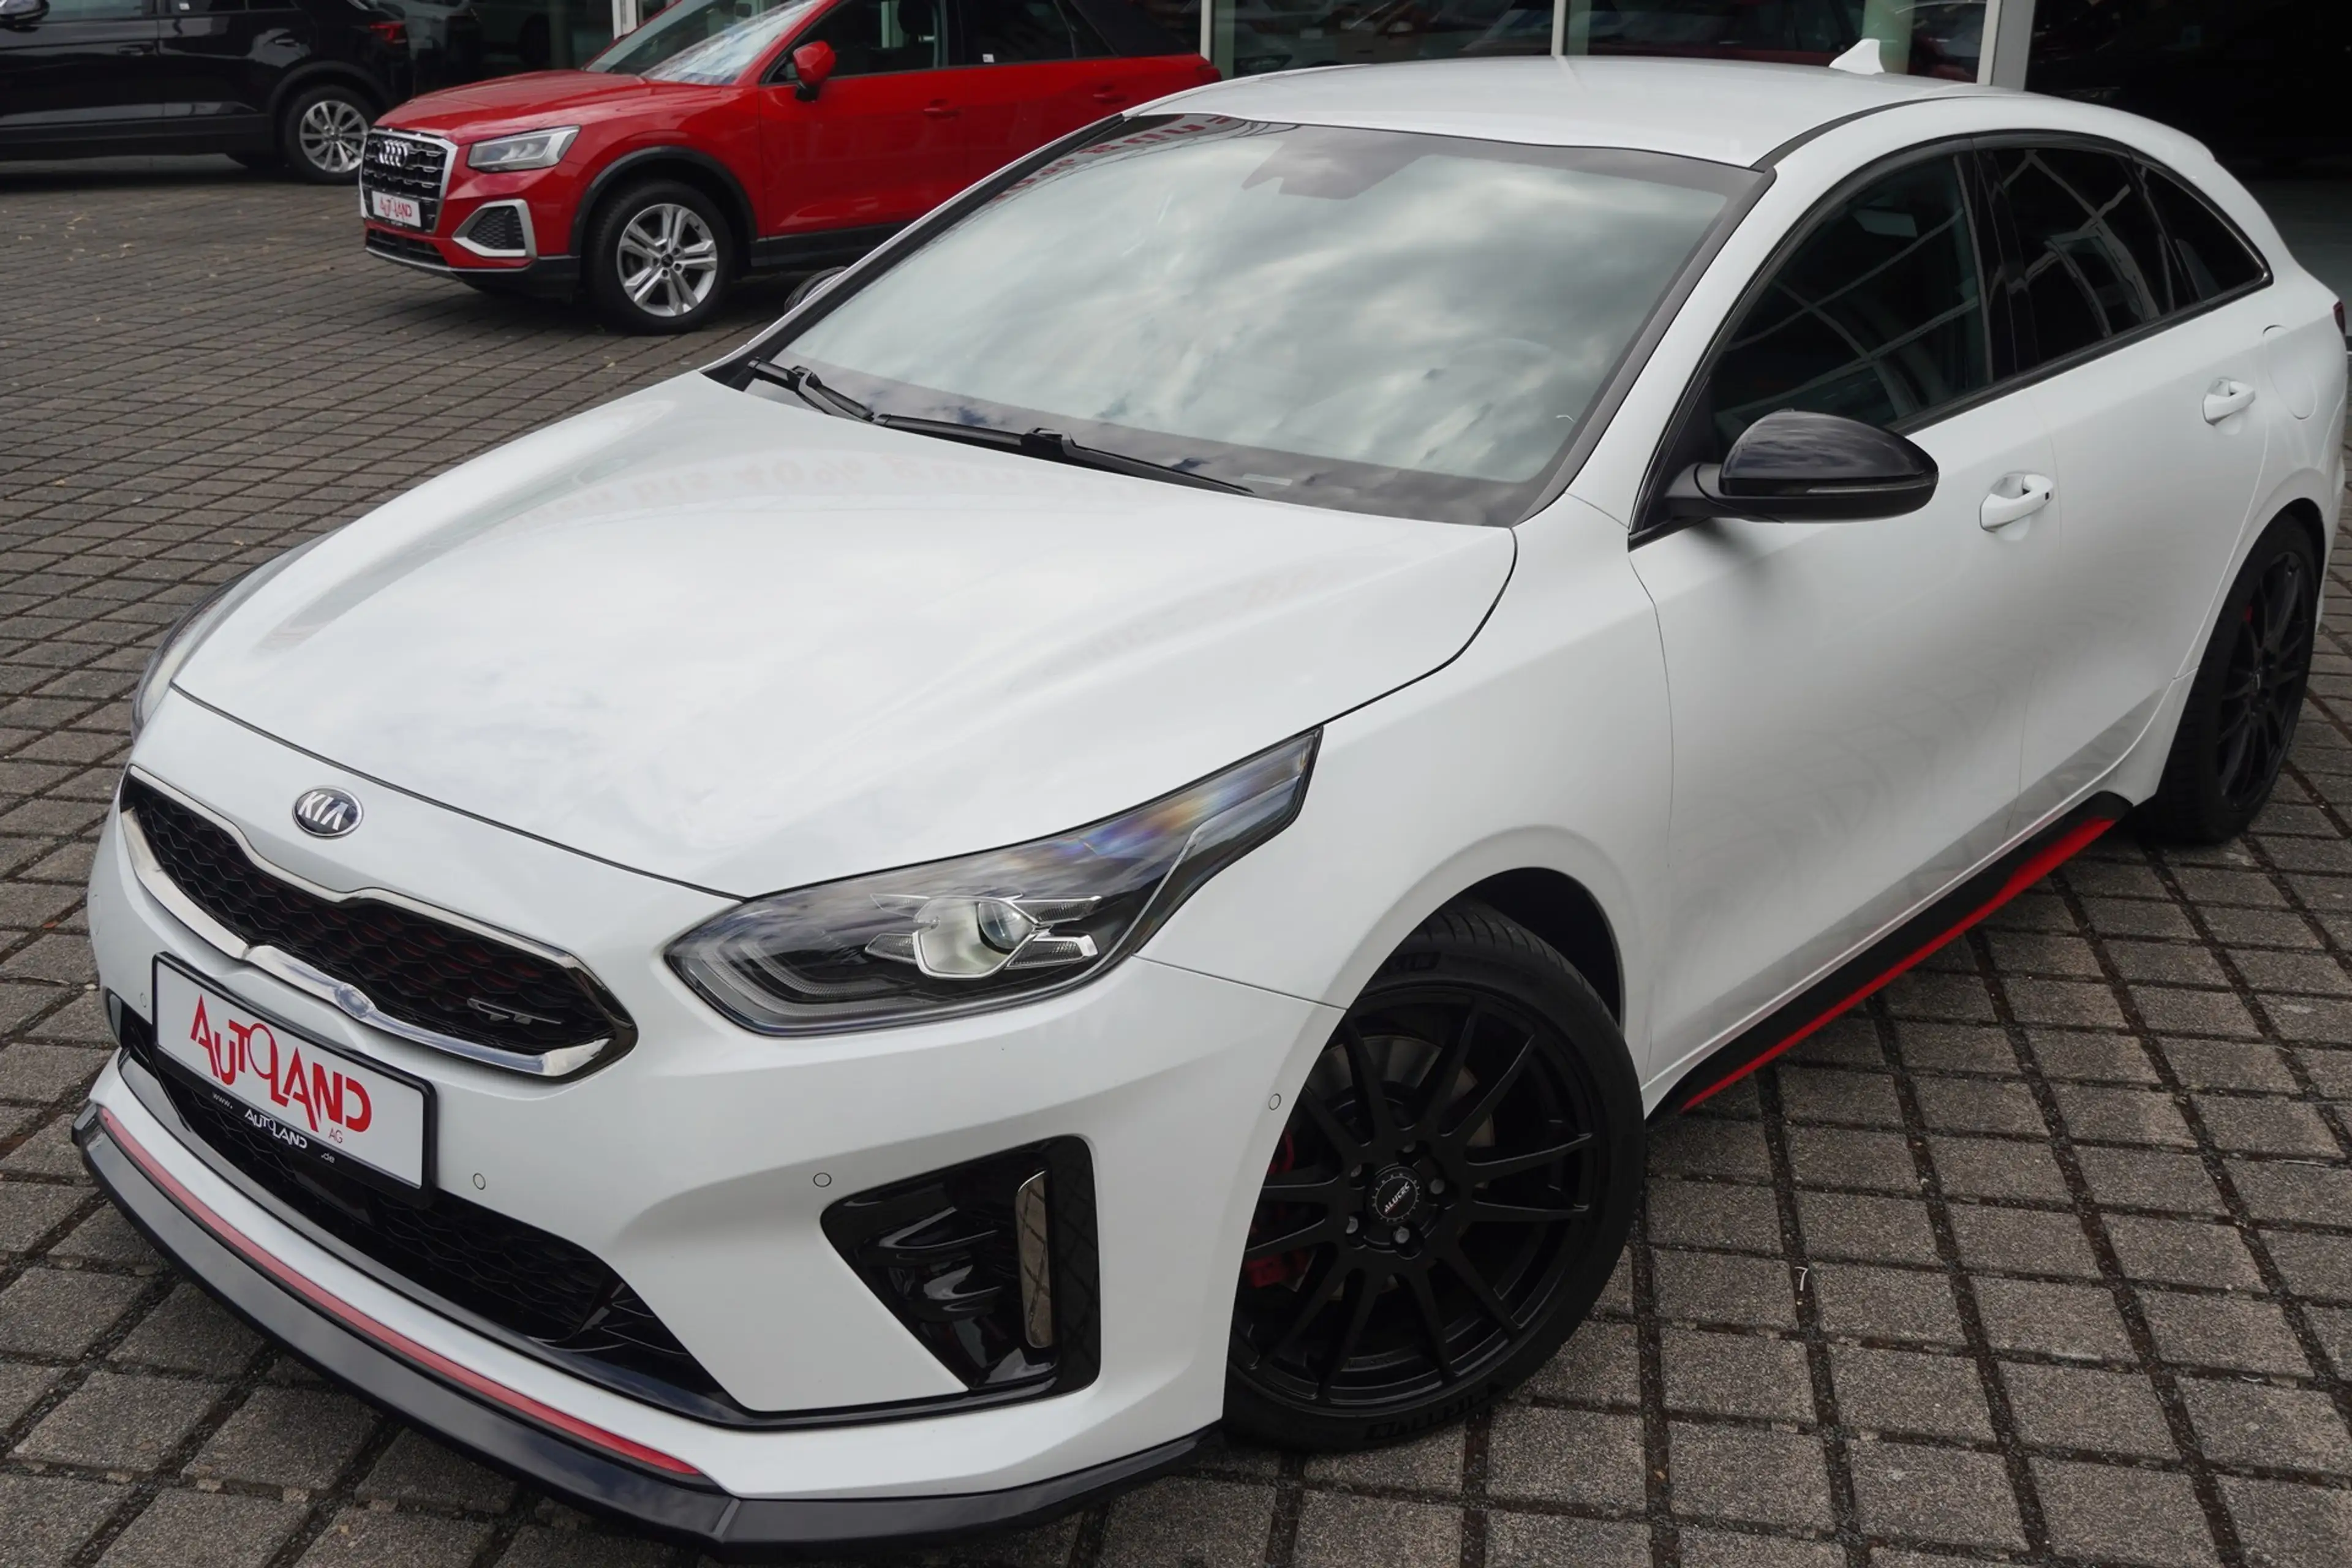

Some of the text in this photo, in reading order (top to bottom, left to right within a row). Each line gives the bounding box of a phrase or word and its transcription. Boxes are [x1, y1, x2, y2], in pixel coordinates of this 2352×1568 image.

[298, 791, 349, 831] KIA
[190, 993, 372, 1133] AUTOLAND
[244, 1109, 307, 1150] AUTOLAND
[328, 1128, 343, 1144] AG
